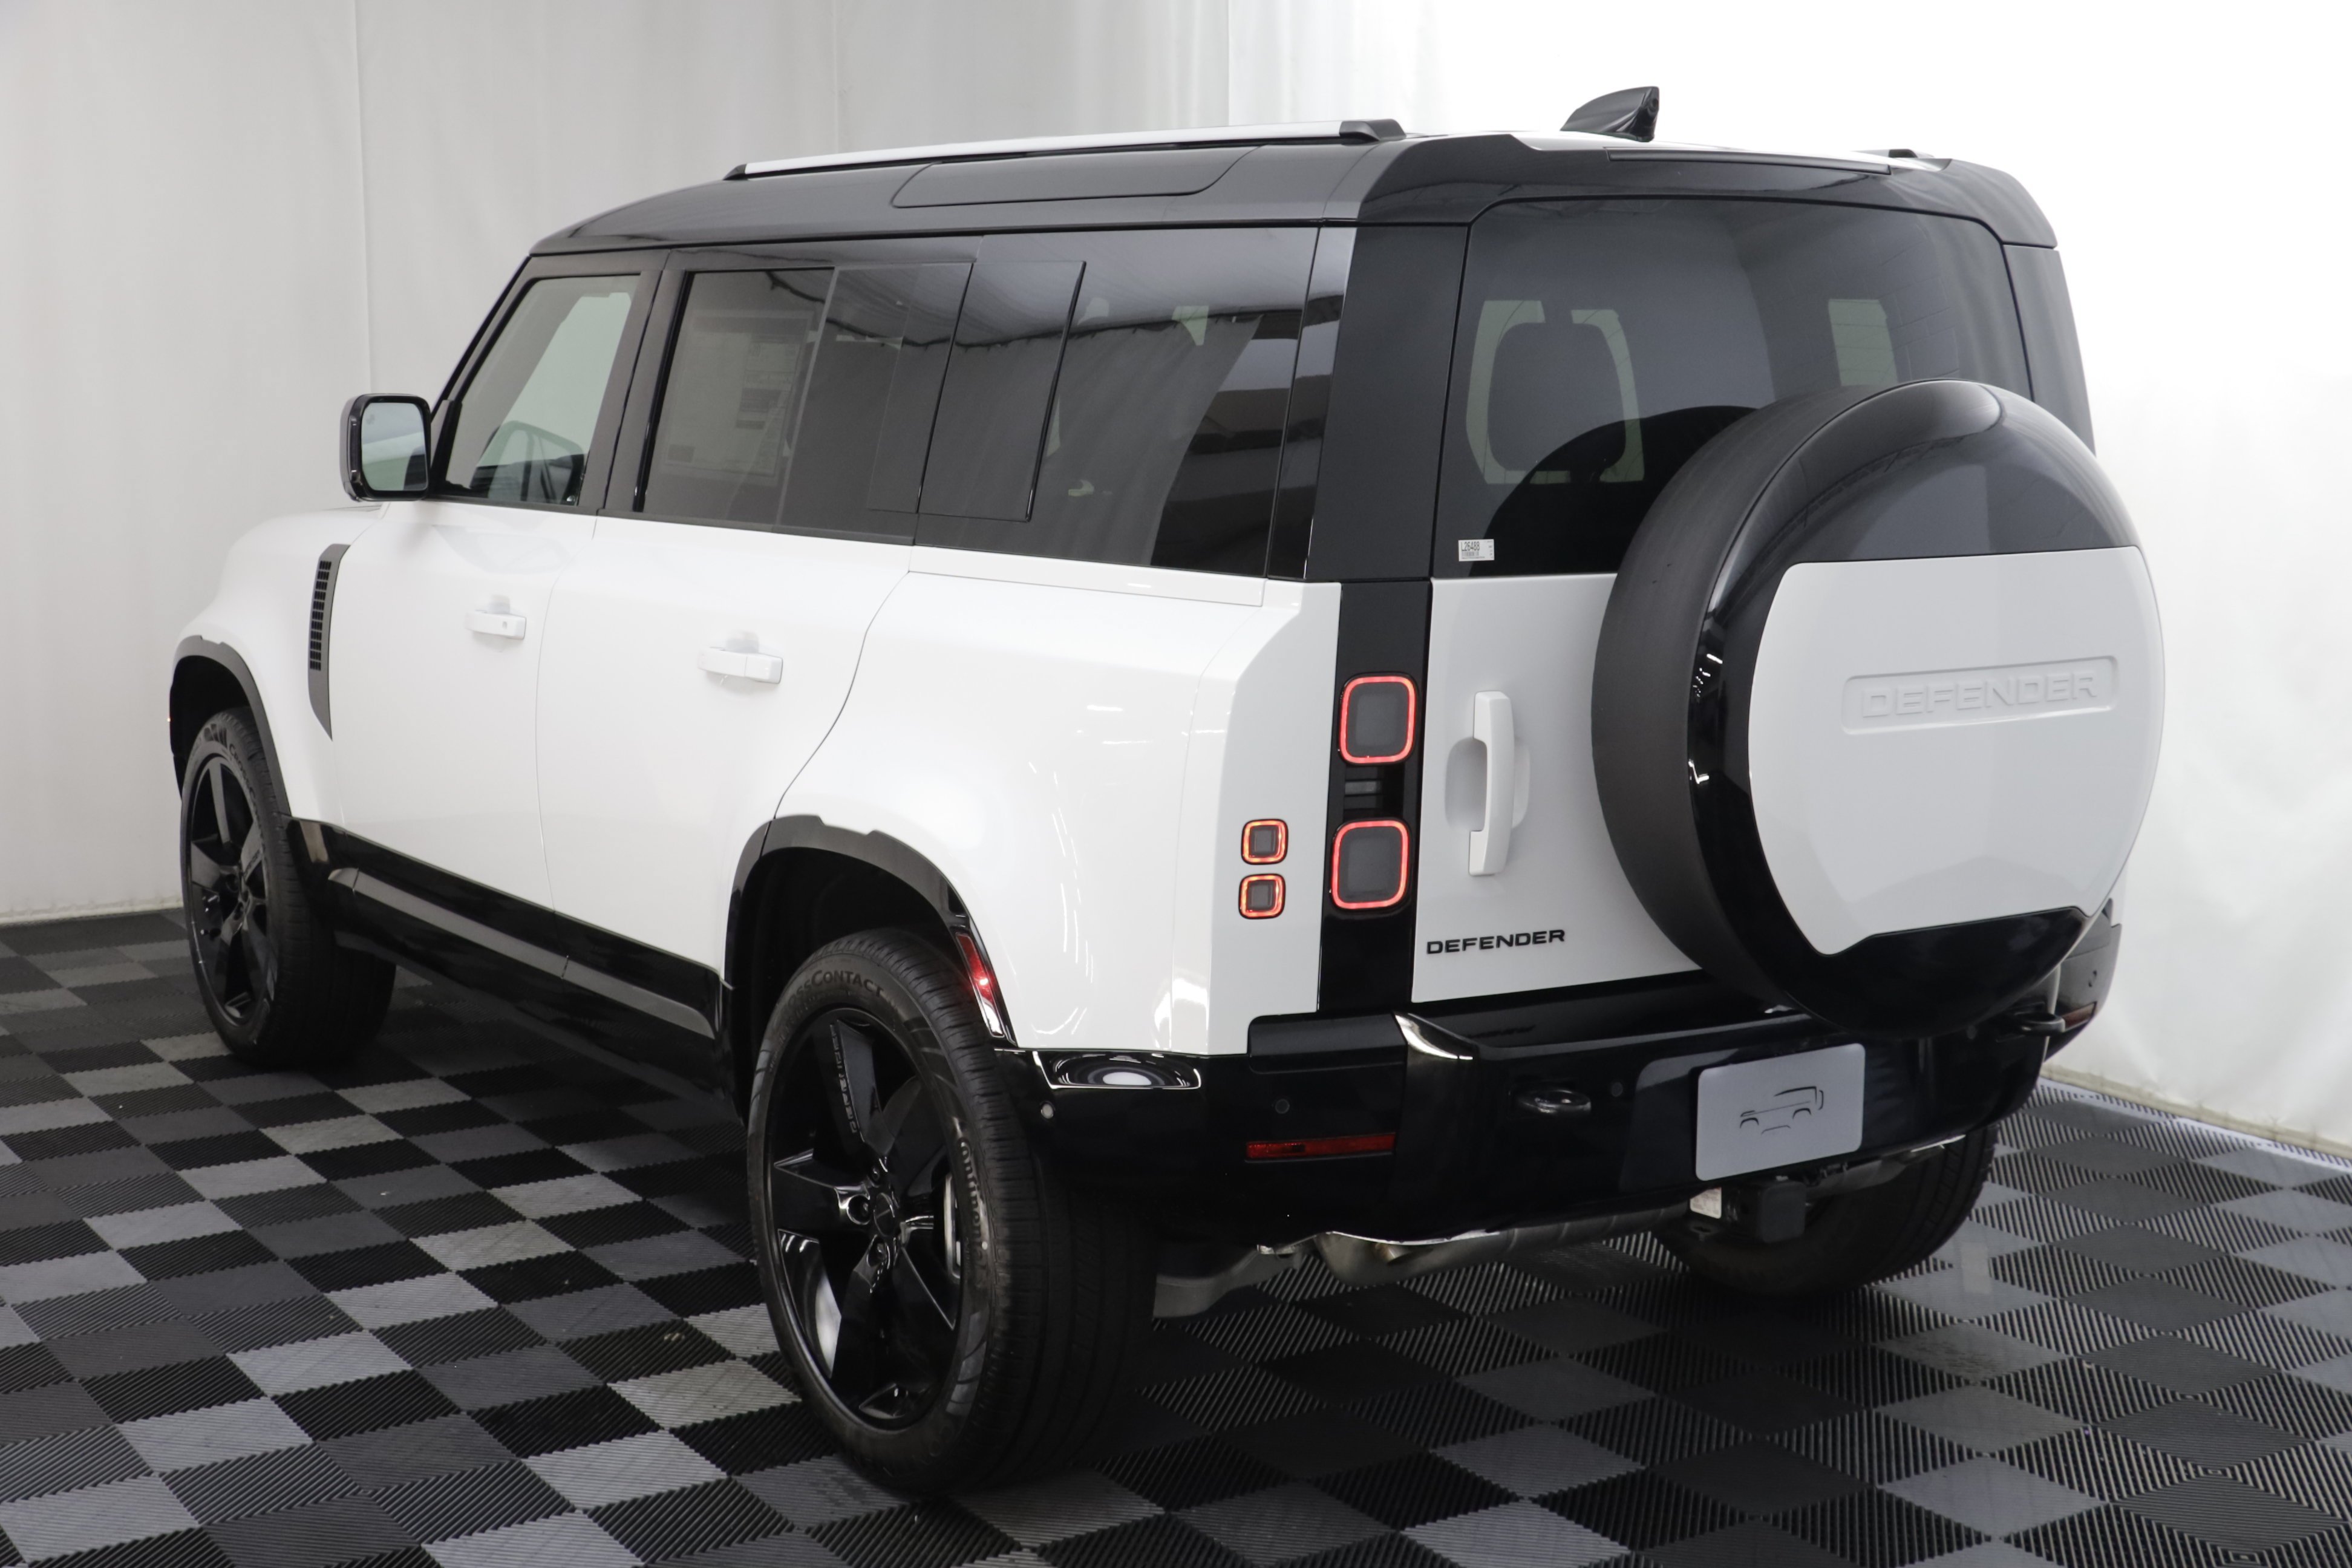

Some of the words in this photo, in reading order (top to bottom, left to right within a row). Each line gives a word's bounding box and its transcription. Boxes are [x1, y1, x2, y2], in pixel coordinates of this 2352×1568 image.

[1862, 671, 2098, 718] DEFENDER
[1426, 929, 1566, 955] DEFENDER
[780, 970, 884, 1016] OSSCONTACT
